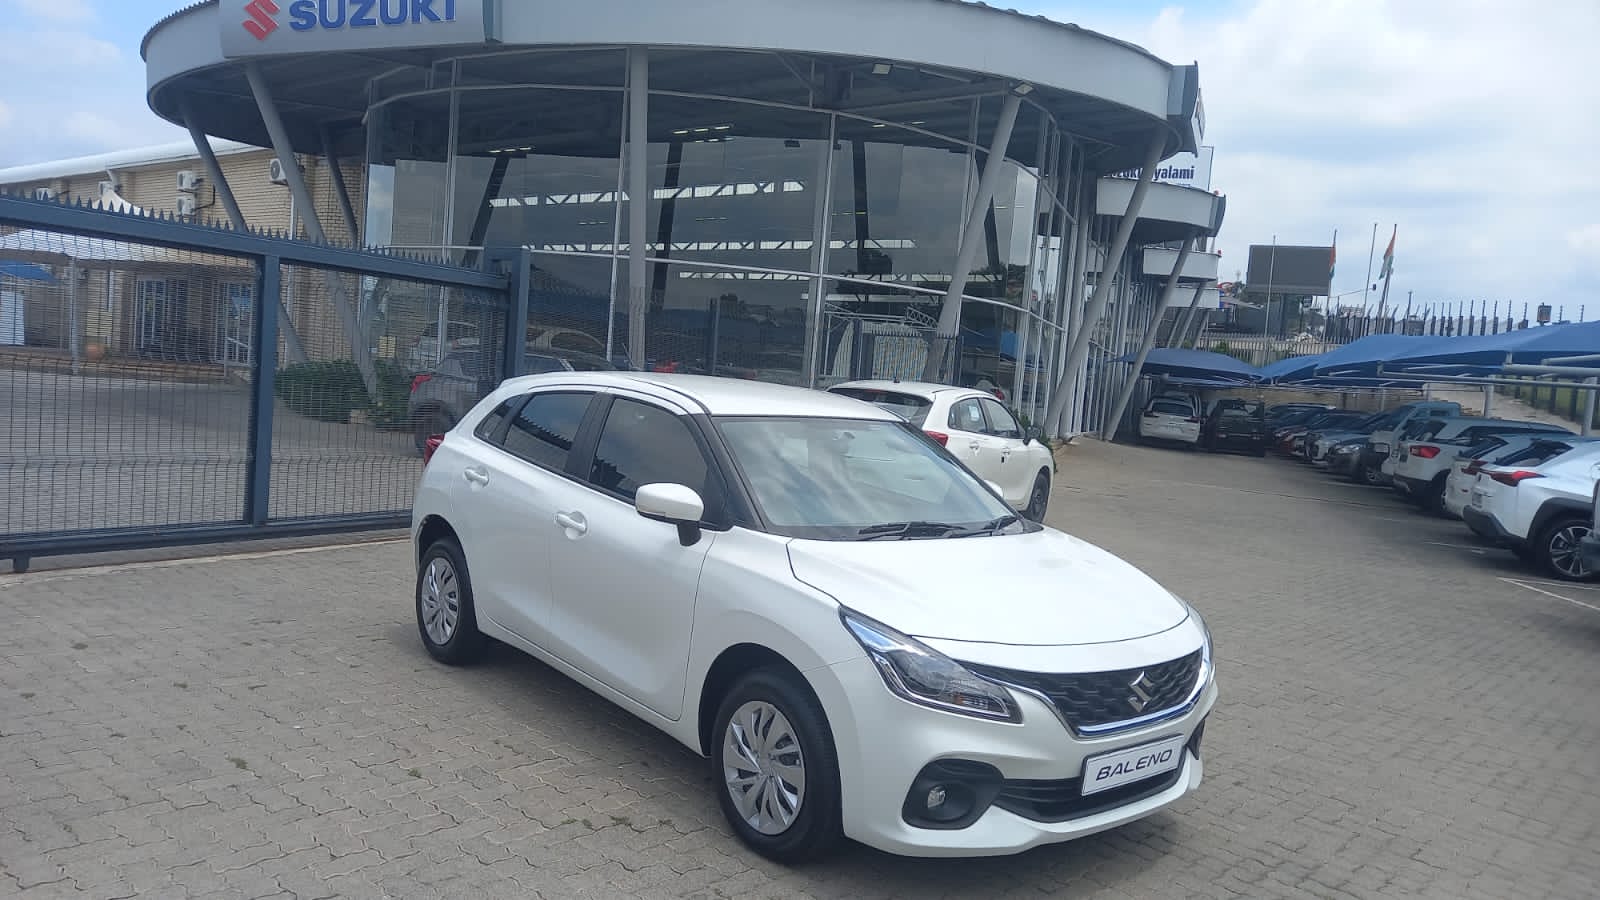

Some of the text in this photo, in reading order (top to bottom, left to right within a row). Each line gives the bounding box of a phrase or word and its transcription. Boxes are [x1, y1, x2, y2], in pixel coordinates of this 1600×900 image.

[289, 0, 456, 31] SUZUKI
[1152, 165, 1195, 181] yalami
[1096, 749, 1173, 781] BALENO
